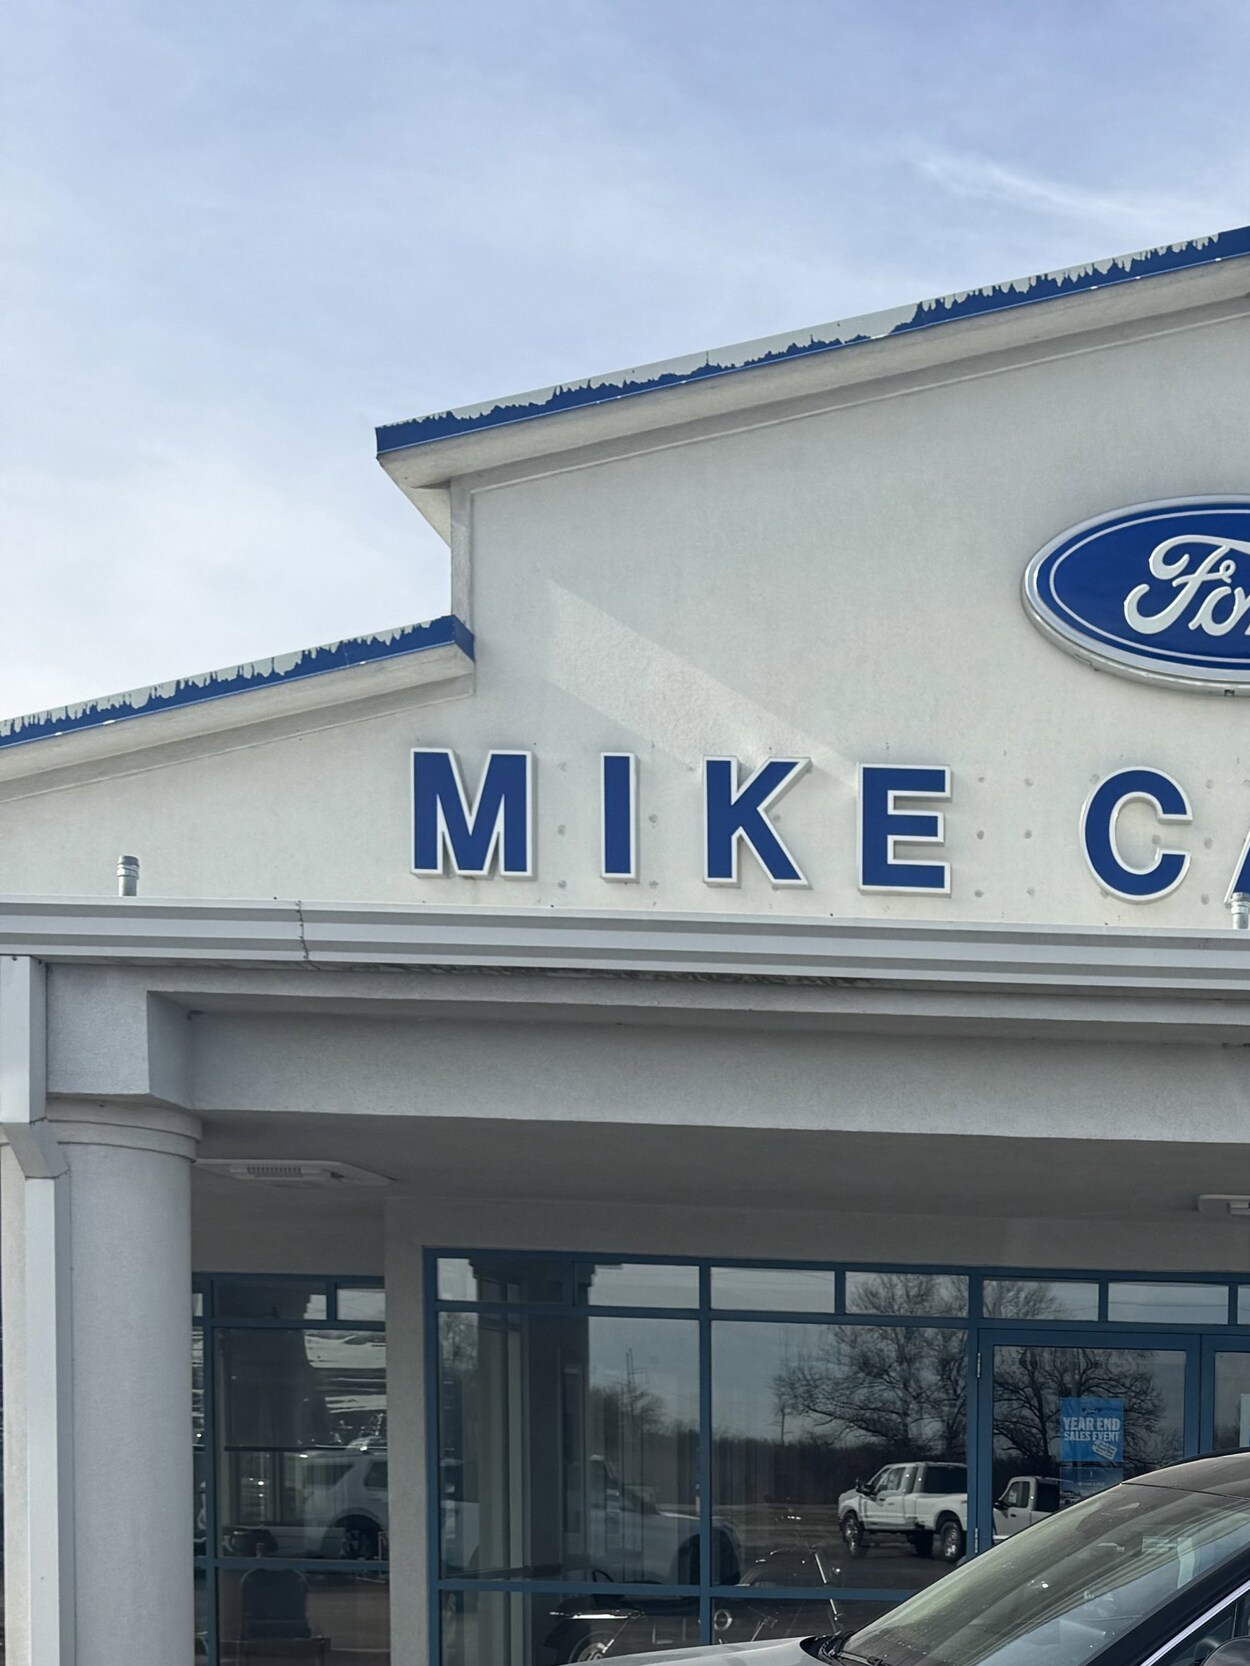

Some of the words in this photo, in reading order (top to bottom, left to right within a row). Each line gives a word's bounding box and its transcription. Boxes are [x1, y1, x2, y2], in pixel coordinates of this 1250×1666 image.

[410, 747, 952, 896] MIKE
[1063, 1417, 1094, 1431] YEAR
[1096, 1417, 1120, 1431] END
[1063, 1431, 1092, 1441] SALES
[1092, 1431, 1120, 1442] EVENT
